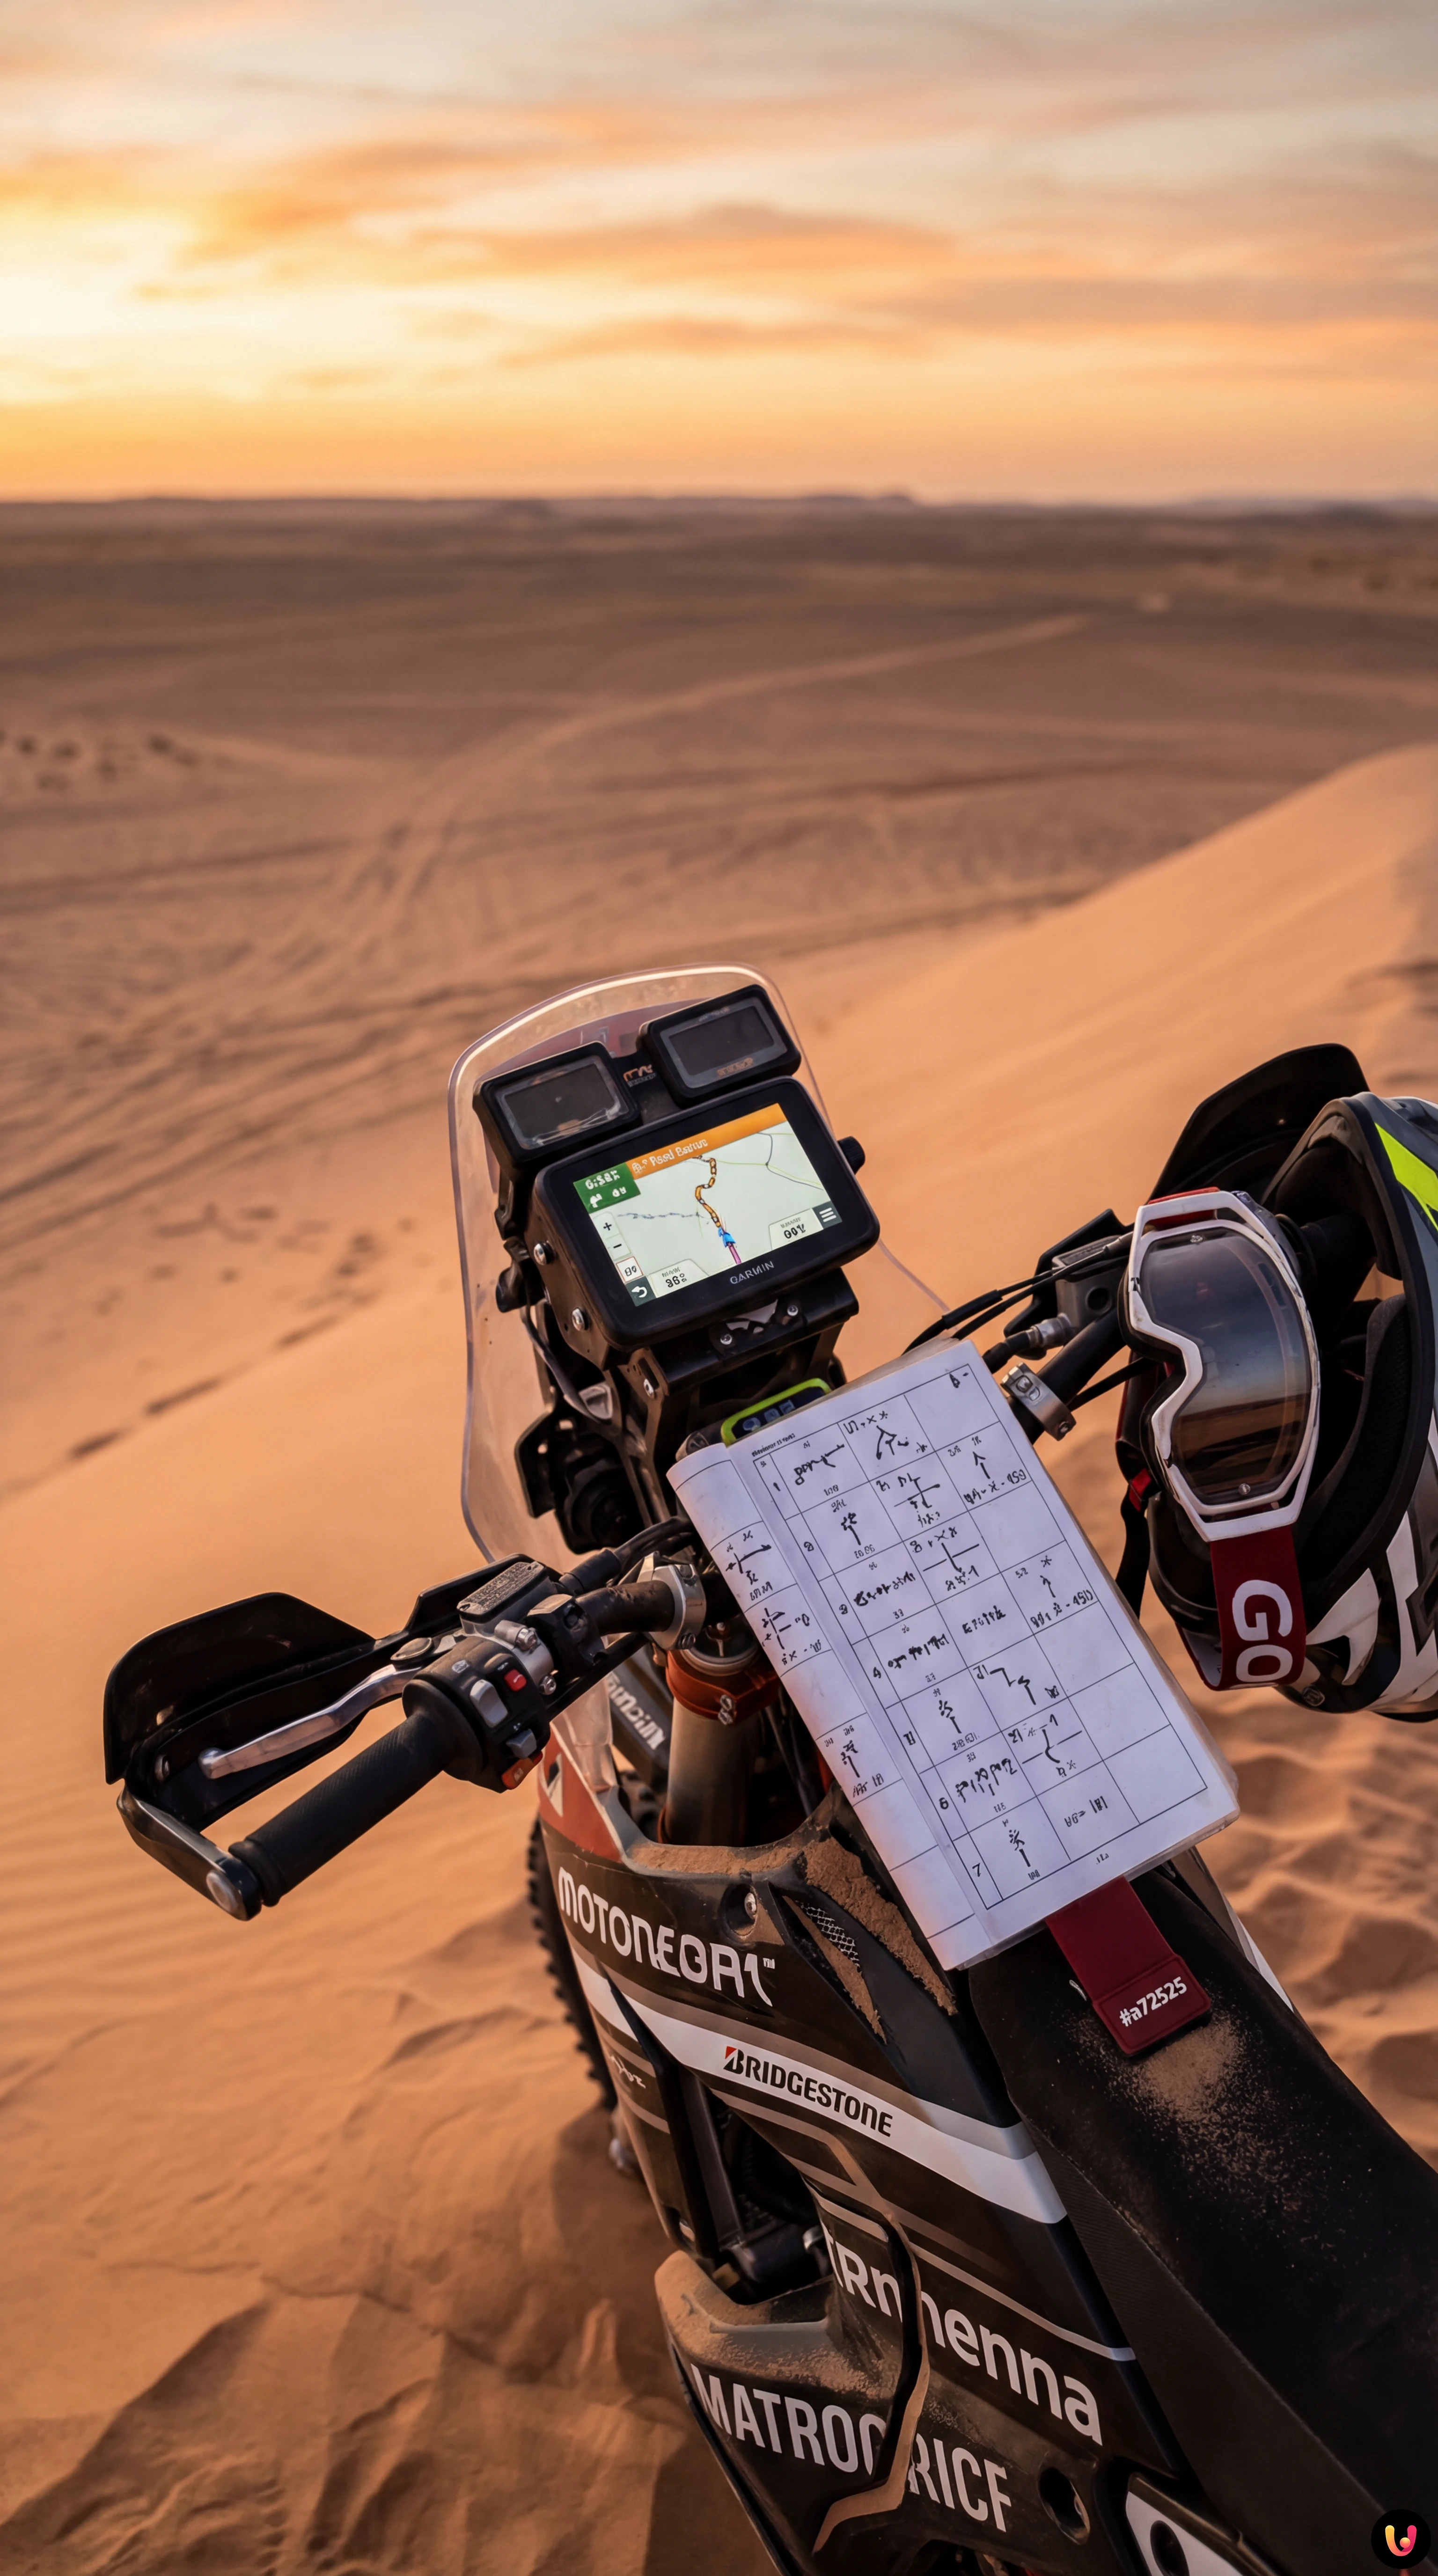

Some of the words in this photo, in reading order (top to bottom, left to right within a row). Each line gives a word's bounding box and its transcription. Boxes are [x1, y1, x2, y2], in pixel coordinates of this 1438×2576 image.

[1229, 1579, 1293, 1689] GO
[1119, 1976, 1187, 2027] #a72525
[723, 2045, 893, 2137] BRIDGESTONE
